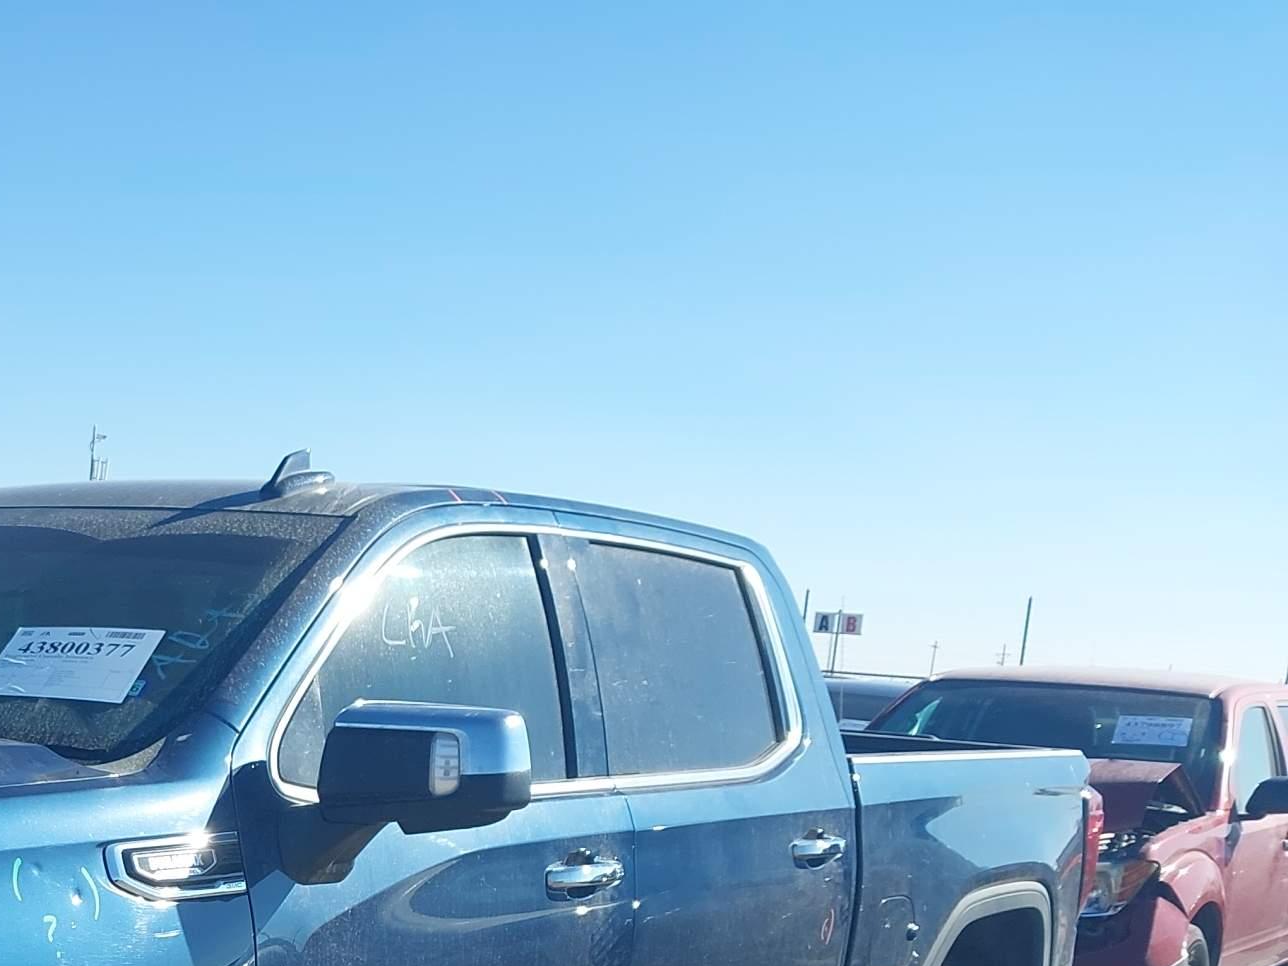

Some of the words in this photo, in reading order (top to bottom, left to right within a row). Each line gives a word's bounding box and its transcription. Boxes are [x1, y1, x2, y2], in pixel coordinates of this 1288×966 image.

[818, 615, 829, 631] A
[846, 616, 857, 632] B
[18, 641, 136, 658] 43800377
